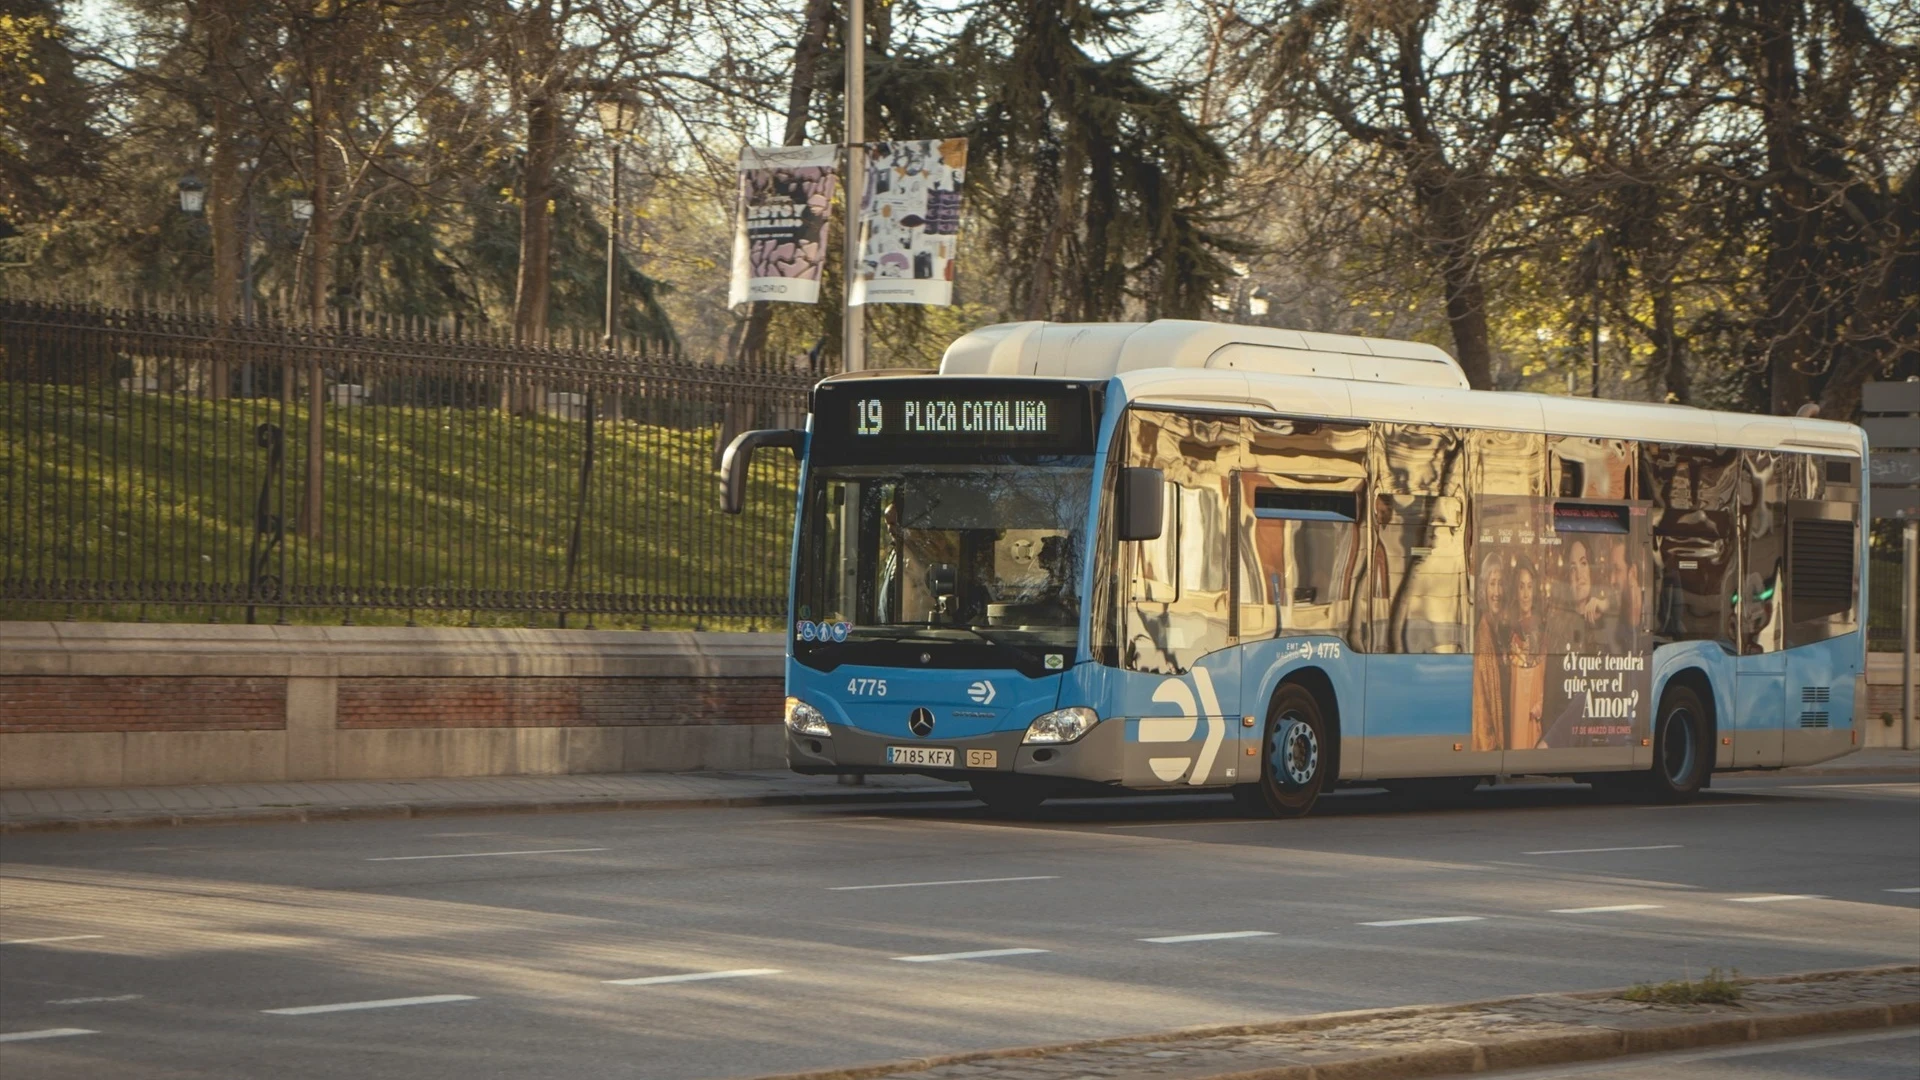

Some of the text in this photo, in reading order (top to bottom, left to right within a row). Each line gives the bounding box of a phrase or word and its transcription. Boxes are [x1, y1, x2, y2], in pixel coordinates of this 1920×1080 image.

[856, 398, 1047, 435] 19 PLAZA CATALUÑA
[1286, 642, 1299, 650] EMT
[1317, 642, 1341, 659] 4775
[1579, 651, 1602, 677] qué
[1605, 650, 1644, 671] tendrá
[847, 678, 887, 697] 4775
[1564, 672, 1622, 699] que ver el
[1582, 688, 1639, 718] Amor?
[1571, 725, 1632, 735] 17 DE MARZO EN CINES
[894, 749, 952, 765] 7185 KFX
[971, 751, 993, 765] SP
